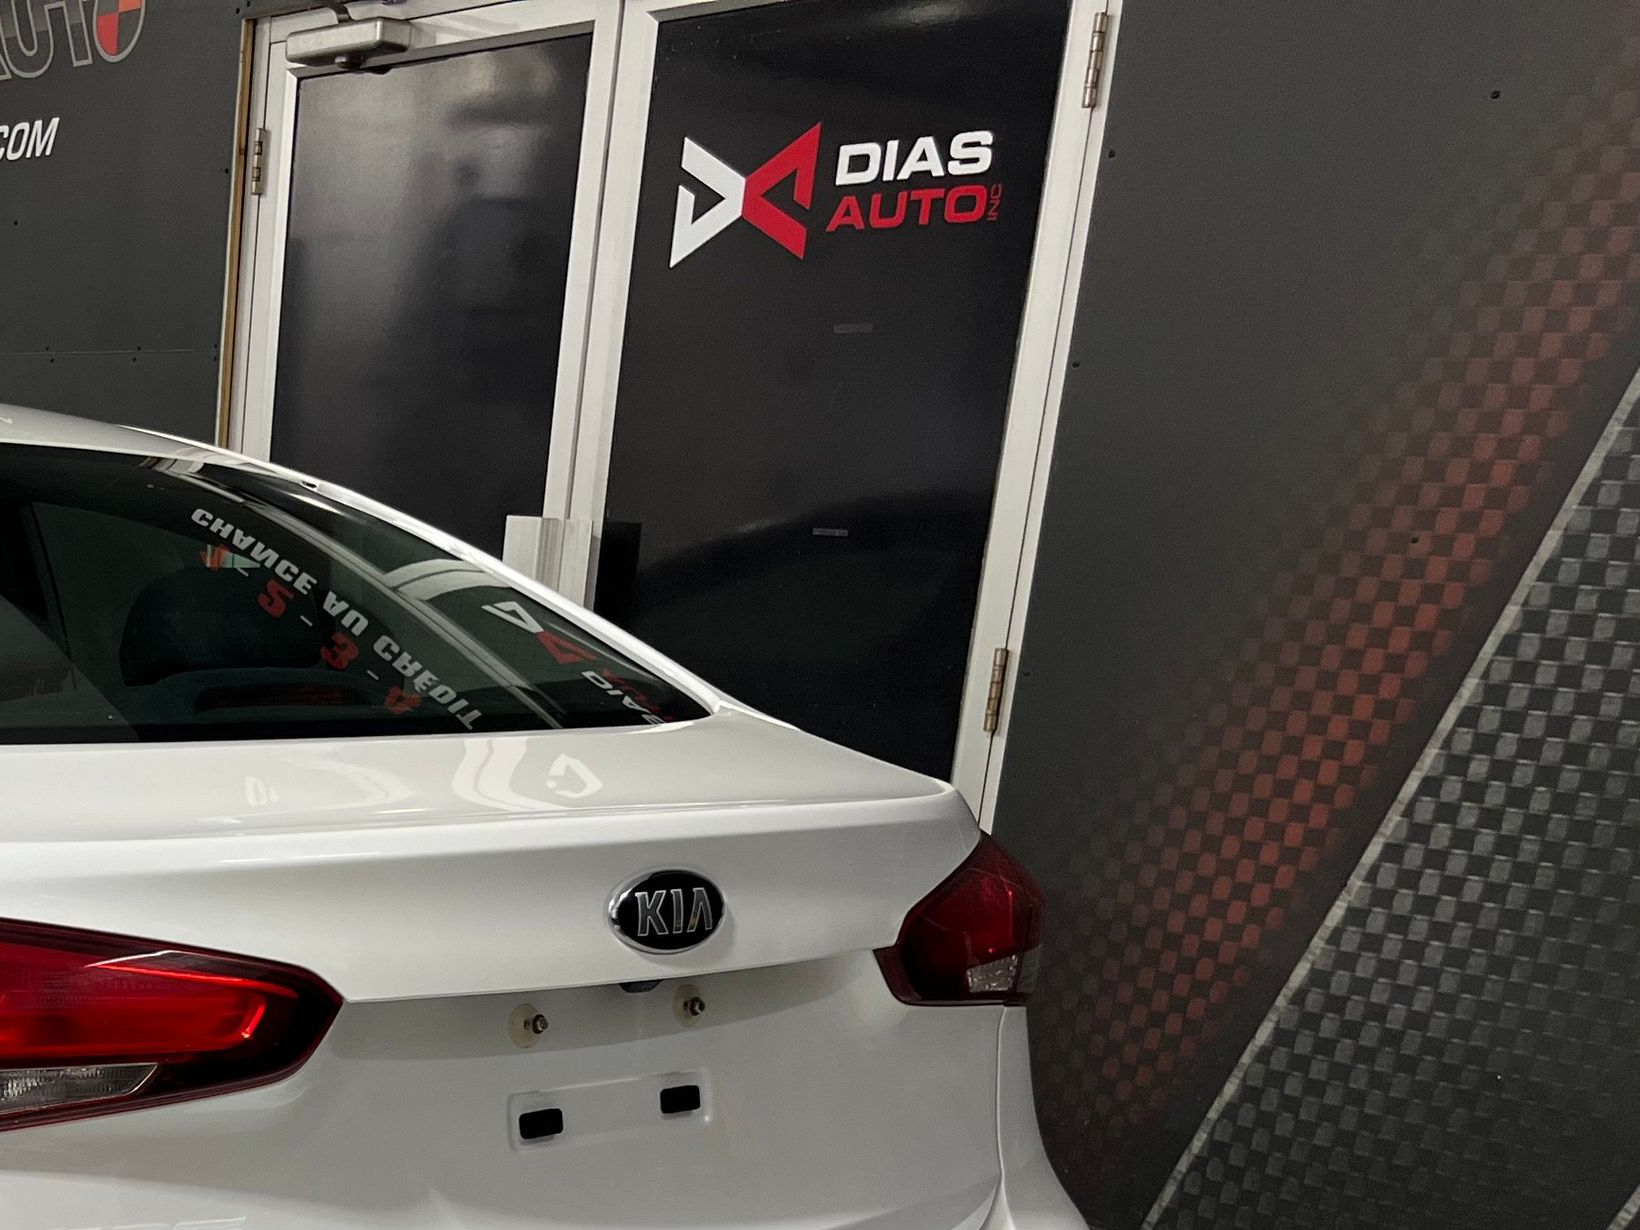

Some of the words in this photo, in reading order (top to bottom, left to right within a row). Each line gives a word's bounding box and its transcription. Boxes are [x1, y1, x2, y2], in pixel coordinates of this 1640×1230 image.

[835, 130, 994, 186] DIAS
[825, 184, 988, 232] AUTO
[634, 887, 714, 937] KIA
